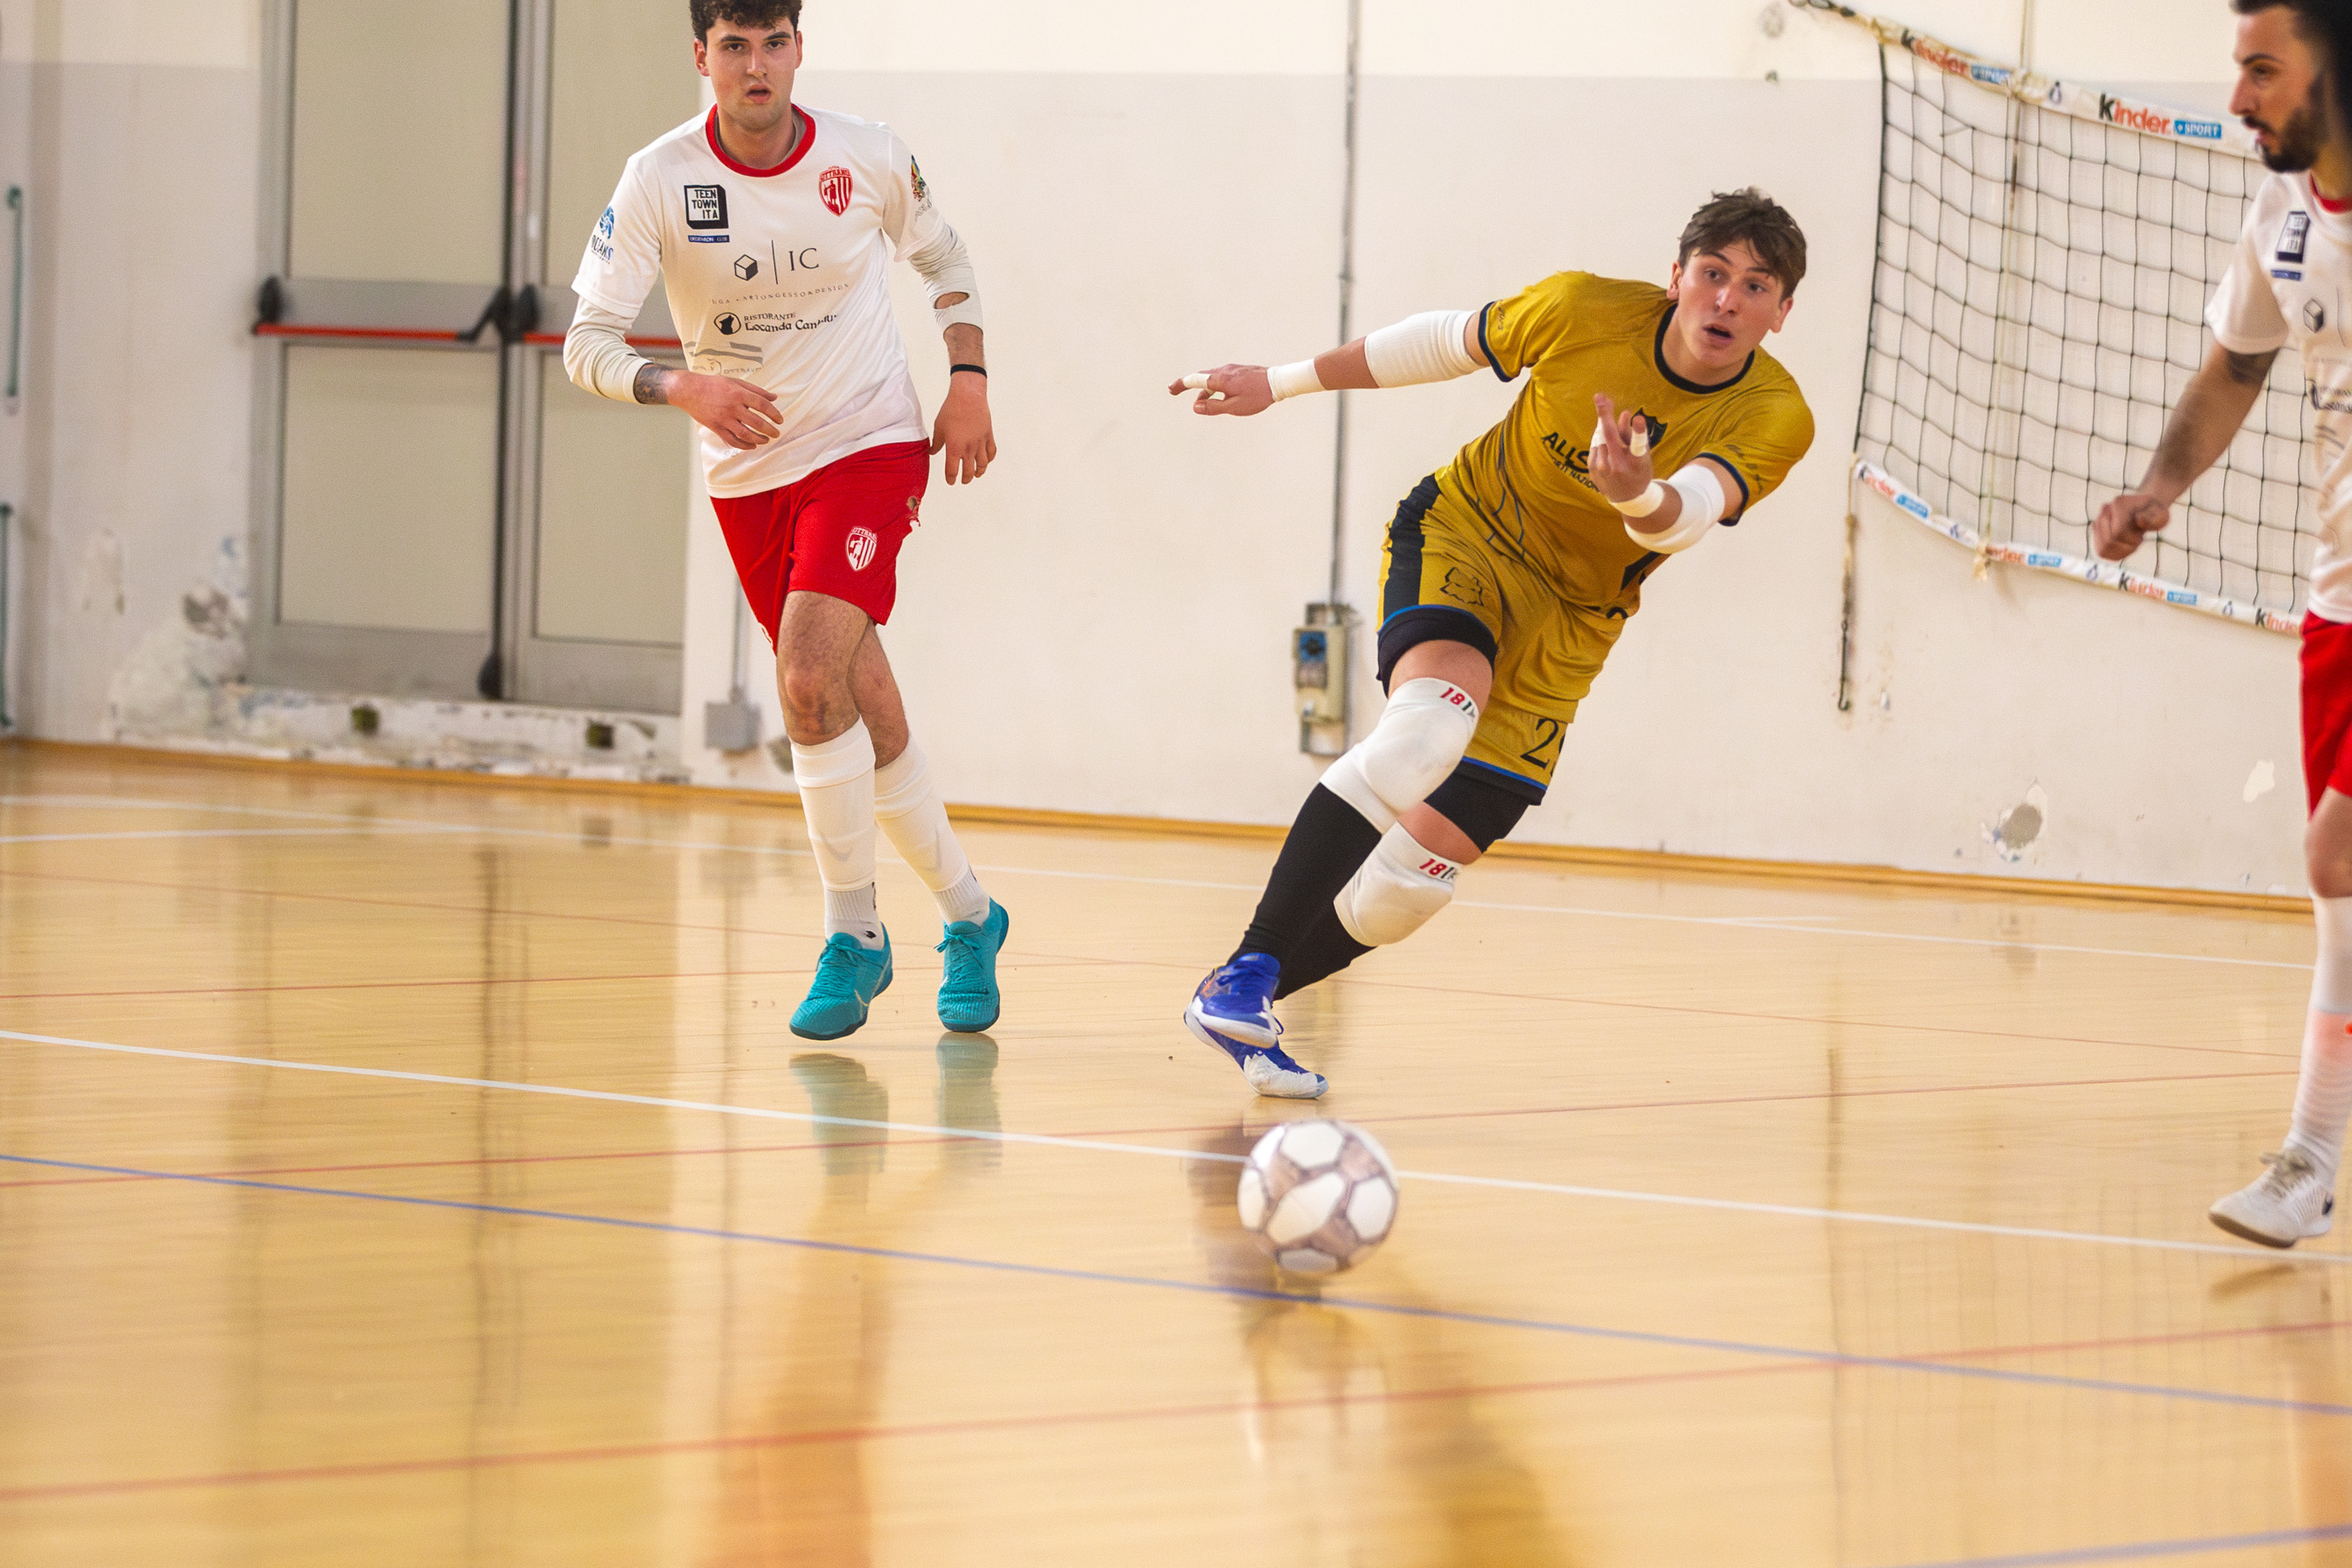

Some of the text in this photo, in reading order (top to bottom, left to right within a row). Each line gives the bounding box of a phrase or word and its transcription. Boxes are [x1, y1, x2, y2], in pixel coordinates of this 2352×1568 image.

[694, 189, 717, 199] TEEN
[692, 199, 718, 209] TOWN
[702, 209, 719, 220] ITA
[788, 247, 819, 271] IC
[744, 312, 796, 321] RISTORANTE
[745, 321, 792, 332] Locanda
[1519, 718, 1566, 777] 2
